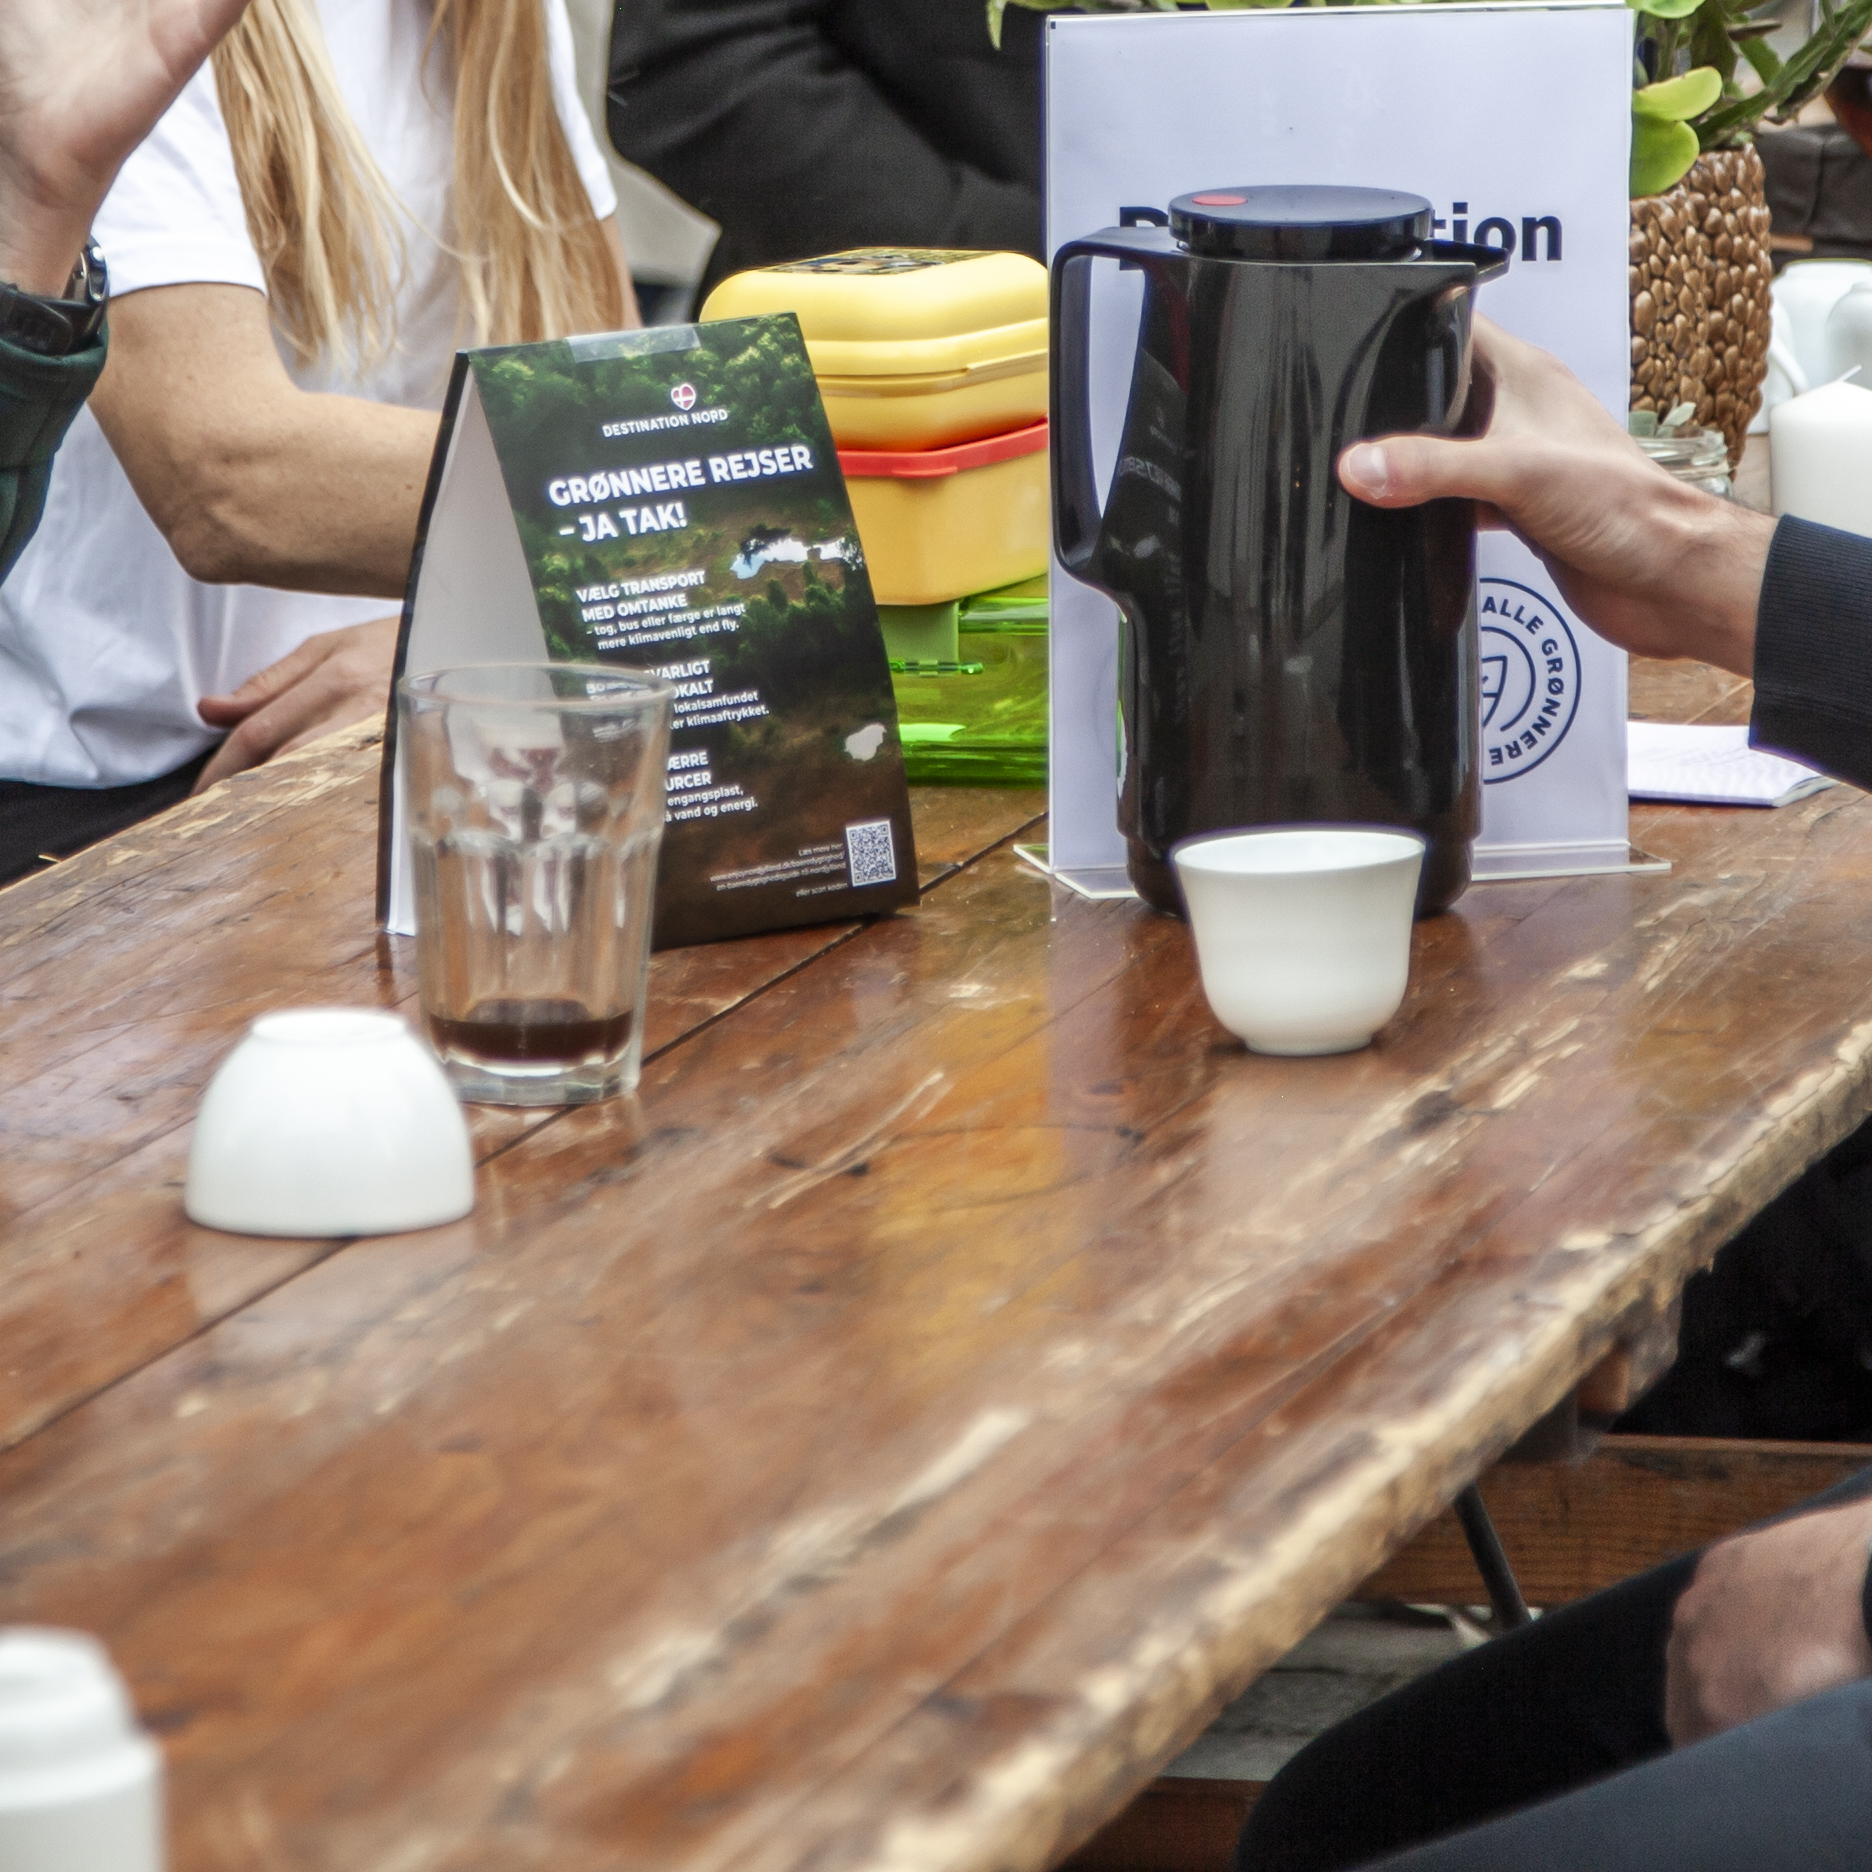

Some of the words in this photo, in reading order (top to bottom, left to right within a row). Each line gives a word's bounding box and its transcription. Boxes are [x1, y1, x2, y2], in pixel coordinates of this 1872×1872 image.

[602, 414, 689, 438] DESTINATION
[691, 408, 729, 425] NORD
[548, 461, 706, 506] GRØNNERE
[708, 445, 813, 483] REJSER
[579, 513, 618, 542] JA
[619, 501, 687, 536] TAK!
[576, 585, 620, 603] VÆLG
[620, 570, 706, 596] TRANSPORT
[581, 605, 615, 623] MED
[617, 593, 688, 617] OMTANKE
[594, 624, 618, 637] tog,
[619, 619, 639, 633] bus
[641, 614, 666, 629] eller
[668, 611, 701, 626] færge
[703, 610, 715, 619] er
[716, 603, 746, 617] langt
[1482, 596, 1545, 636] ALLE
[597, 637, 627, 651] mere
[628, 624, 698, 647] klimavenligt
[699, 621, 721, 635] end
[721, 618, 740, 632] fly.
[673, 689, 759, 714] lokalsamfundet
[1488, 638, 1566, 766] GRØNNERE
[675, 807, 701, 821] vand
[703, 804, 719, 818] og
[720, 797, 759, 814] energi.
